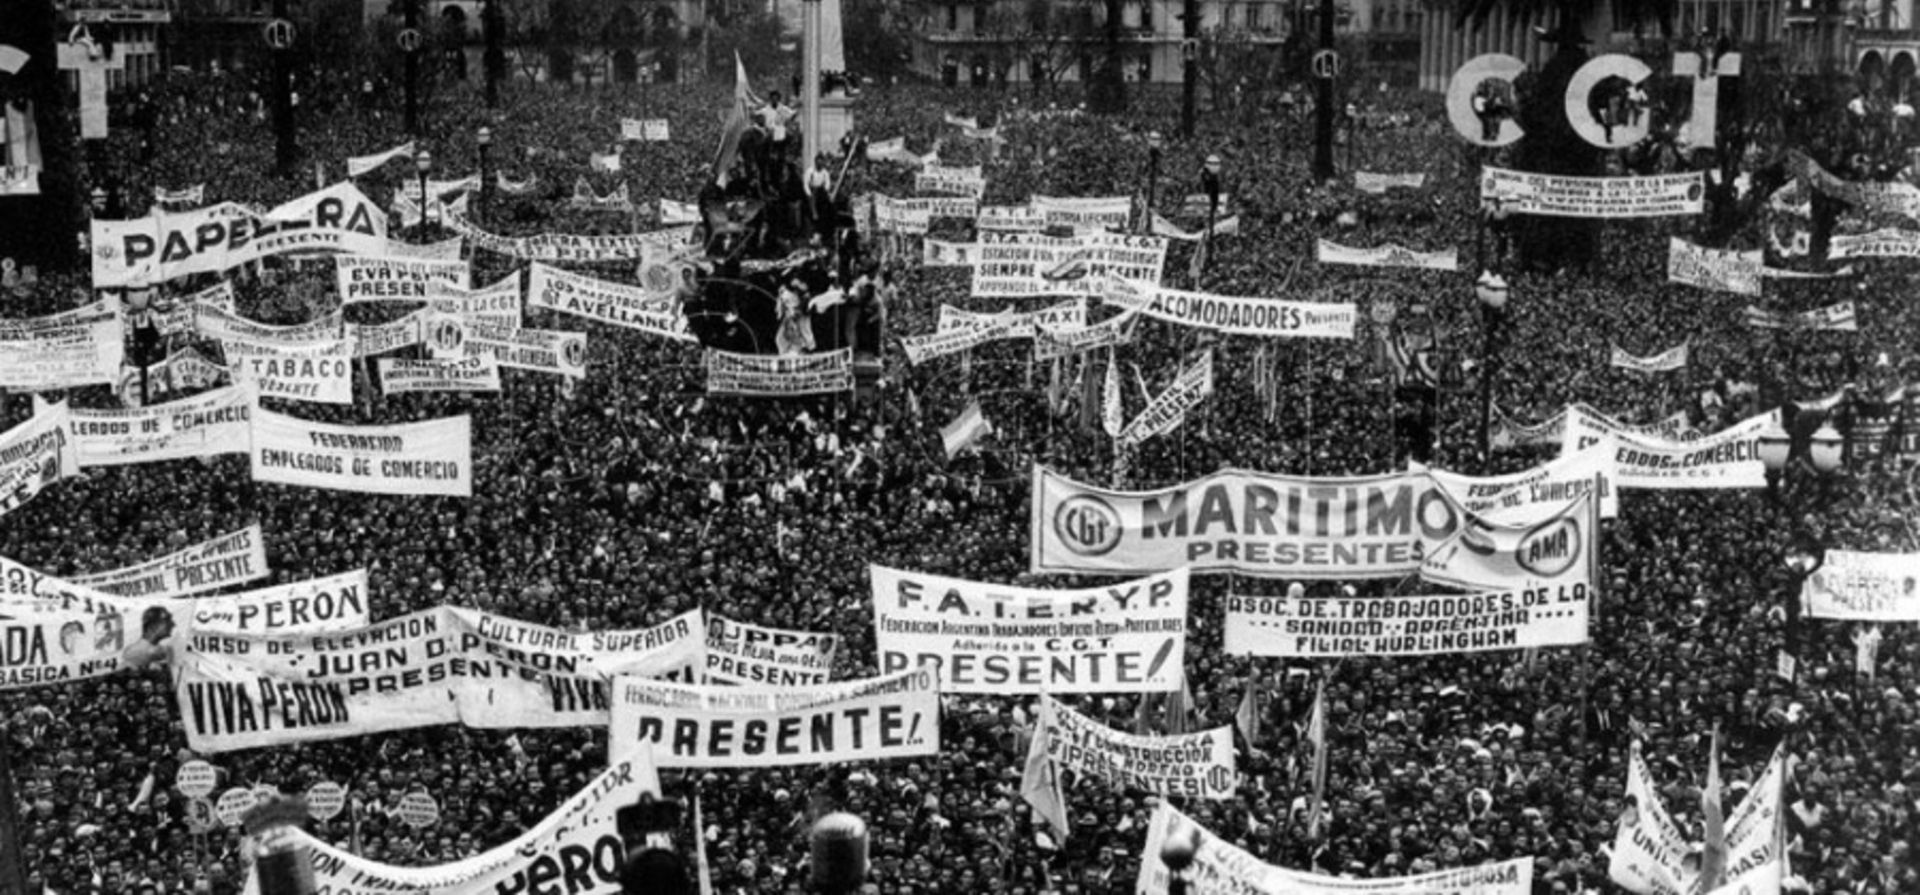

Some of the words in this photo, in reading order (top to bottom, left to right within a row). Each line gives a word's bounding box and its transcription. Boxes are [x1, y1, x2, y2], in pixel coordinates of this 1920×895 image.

[351, 267, 391, 281] EVA
[980, 263, 1036, 278] SIEMPRE
[349, 282, 425, 298] PRESEN
[566, 296, 677, 332] AVELLANE
[1040, 309, 1081, 324] TAXI
[1149, 294, 1302, 330] ACOMODADORES
[250, 358, 346, 378] TABACO
[70, 420, 130, 435] LEADOS
[308, 431, 404, 452] FEDERACION
[261, 447, 344, 475] EMPLEADOS
[351, 457, 372, 477] DE
[381, 460, 459, 480] COMERCIO
[1528, 527, 1569, 563] AMA
[237, 584, 363, 629] PERON
[1558, 582, 1587, 603] LA
[187, 635, 250, 655] URSO
[267, 639, 296, 656] DE
[312, 614, 438, 652] ELEVACION
[478, 615, 581, 652] CULTURAL
[592, 617, 690, 652] SUPERIOR
[952, 638, 1009, 651] Adherida
[706, 653, 825, 687] PRESENTE
[849, 671, 931, 701] SARMIENTO
[188, 682, 258, 736] VIVA
[257, 676, 349, 731] PERON
